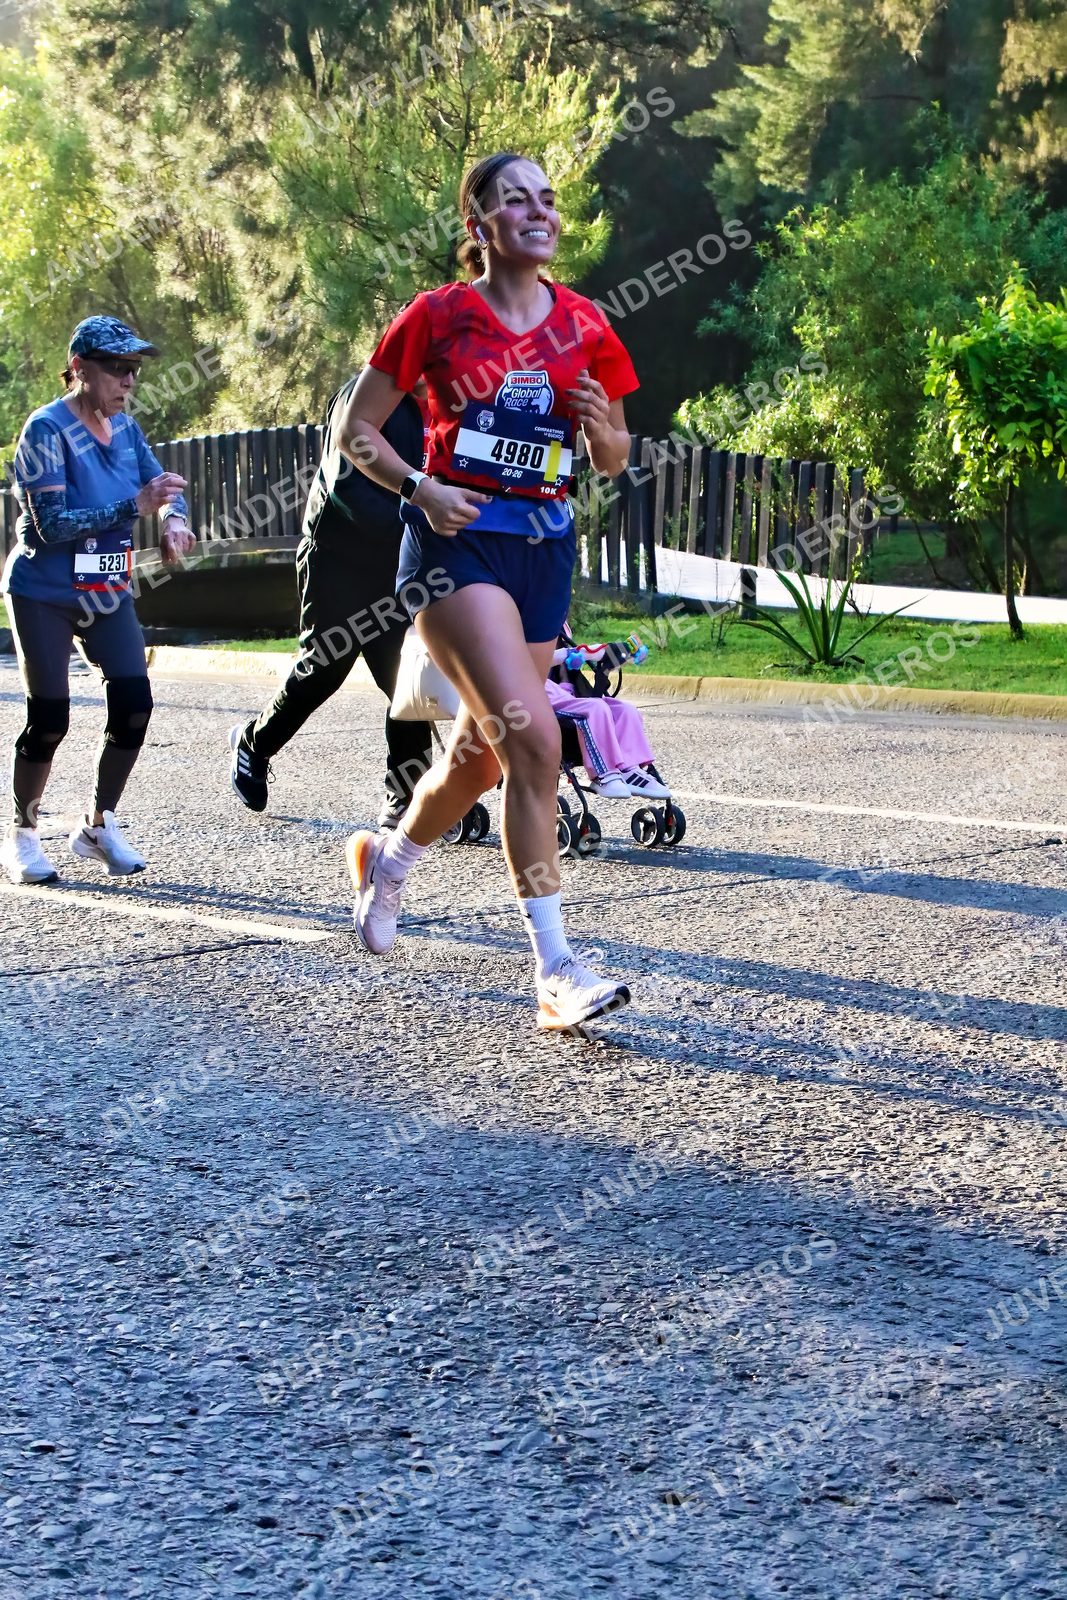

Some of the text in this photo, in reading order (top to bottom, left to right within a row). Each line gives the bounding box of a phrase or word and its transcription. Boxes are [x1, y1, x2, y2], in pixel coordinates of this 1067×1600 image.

[512, 387, 541, 398] Global
[505, 398, 529, 407] Race
[491, 439, 544, 469] 4980
[540, 486, 557, 495] 10K
